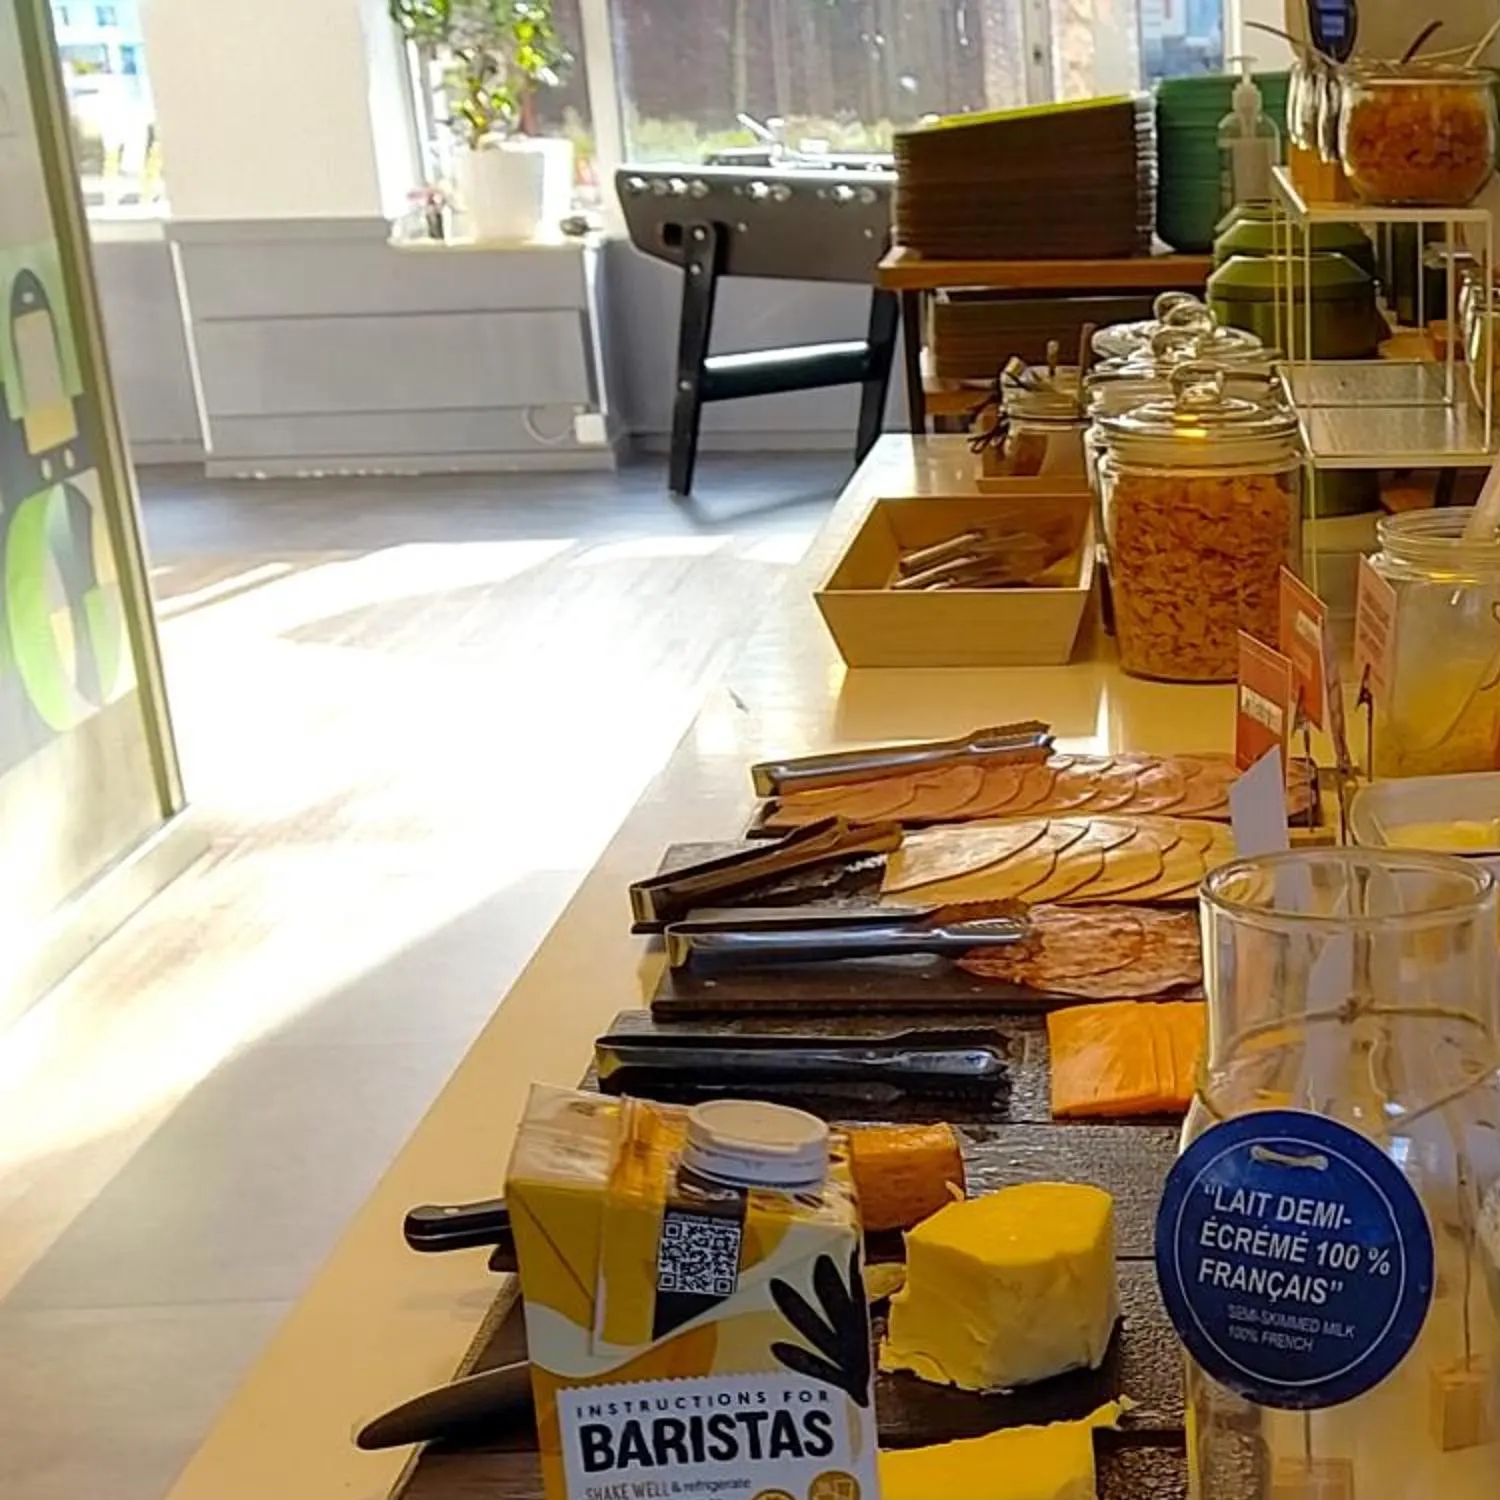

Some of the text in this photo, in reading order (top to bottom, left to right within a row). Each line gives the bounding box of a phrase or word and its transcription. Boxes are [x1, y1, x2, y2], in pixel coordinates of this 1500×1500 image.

[1276, 1195, 1352, 1230] DEMI-
[1200, 1216, 1390, 1276] ÉCRÉMÉ 100 %
[1261, 1331, 1313, 1351] FRENCH
[1322, 1321, 1355, 1338] MILK
[577, 1390, 828, 1418] INSTRUCTIONS FOR
[579, 1410, 834, 1472] BARISTAS
[632, 1480, 669, 1498] WELL
[671, 1481, 682, 1492] &
[683, 1478, 751, 1493] refrigerate
